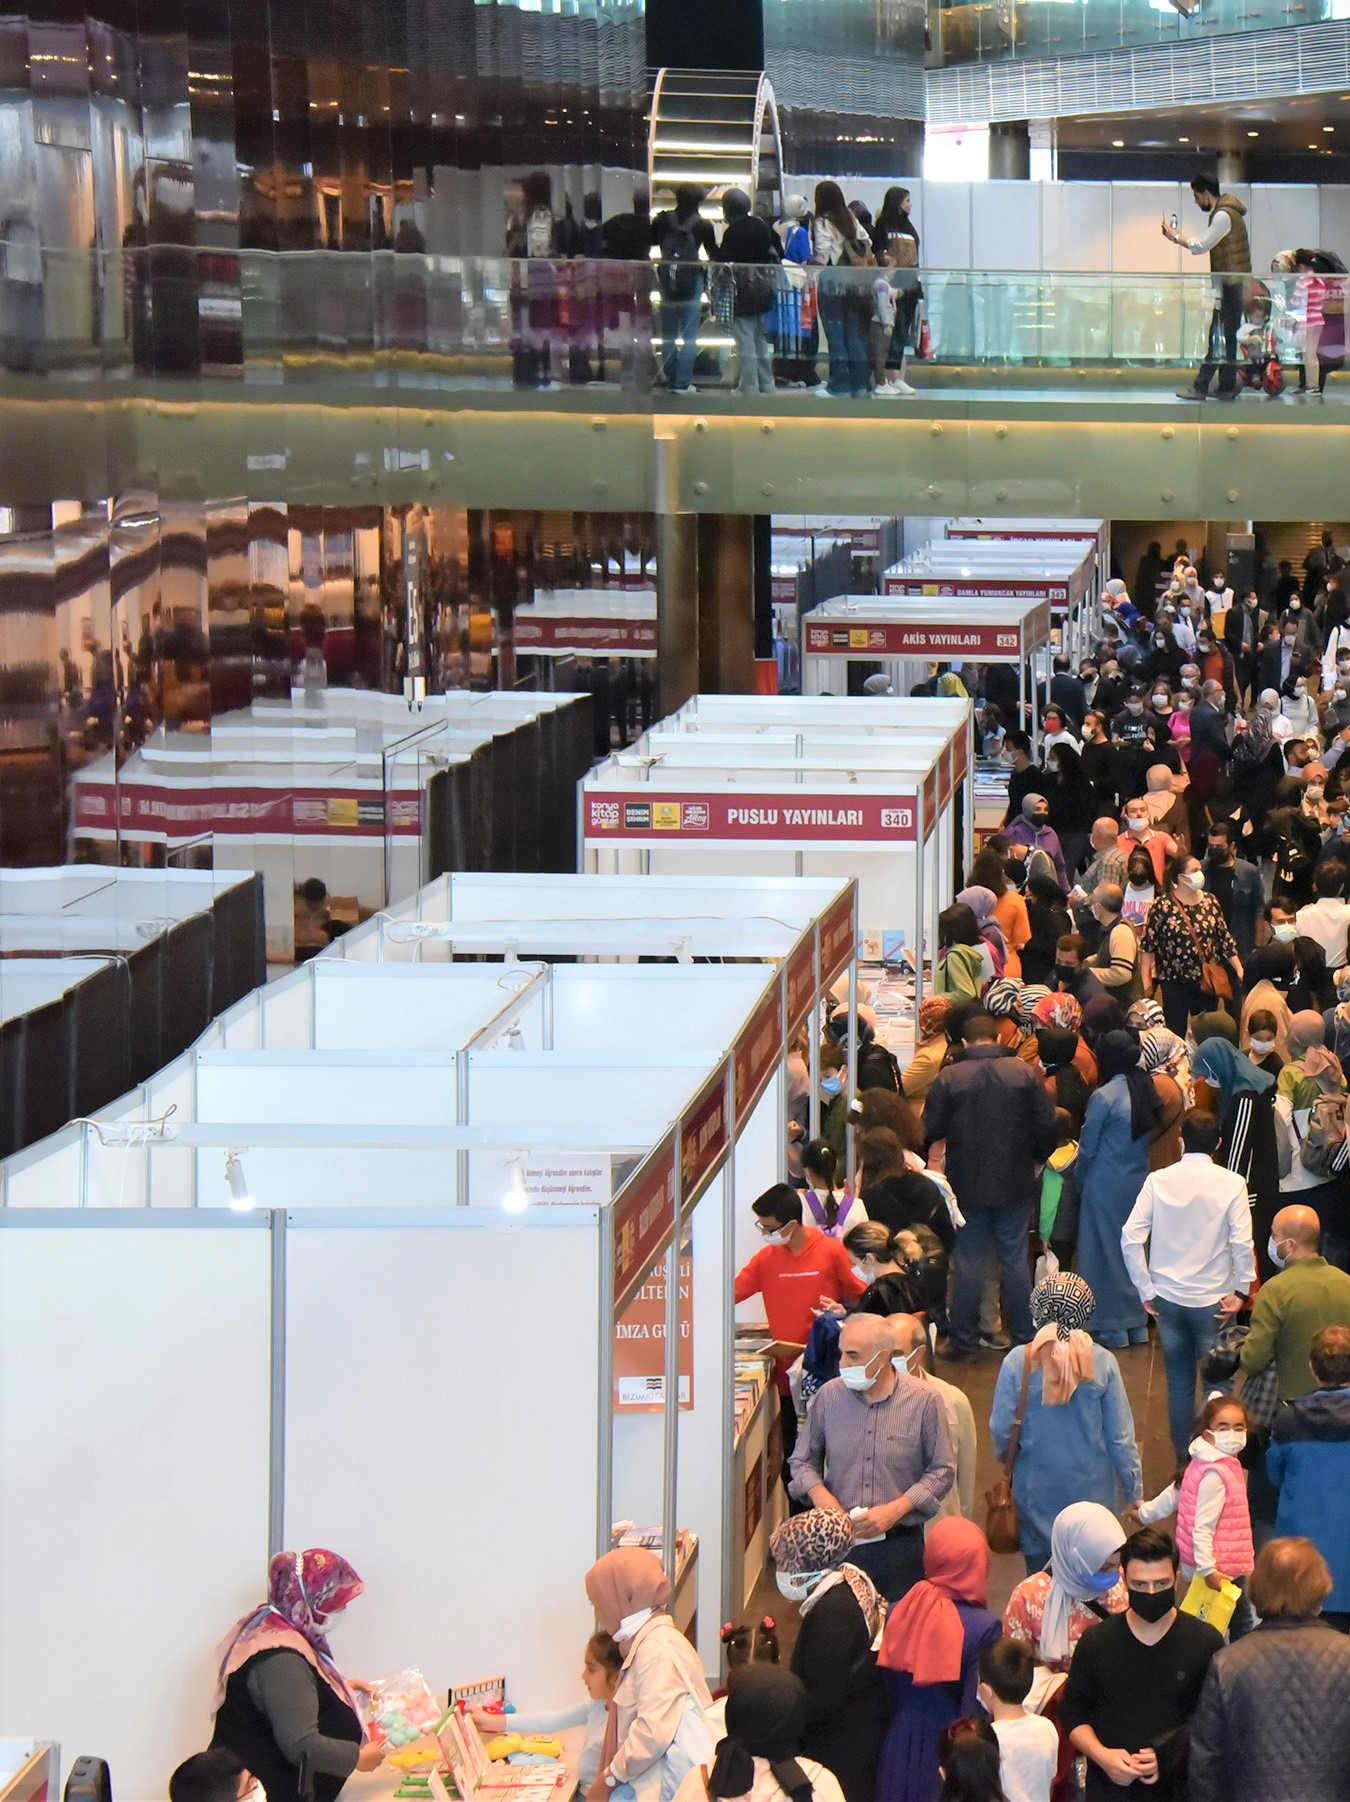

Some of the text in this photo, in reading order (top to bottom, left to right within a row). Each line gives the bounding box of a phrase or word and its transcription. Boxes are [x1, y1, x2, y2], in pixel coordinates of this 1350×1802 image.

[1015, 590, 1047, 598] YAYINLARI
[902, 631, 981, 646] AKİS YAYINLARI
[999, 637, 1015, 646] 342
[591, 801, 619, 811] konya
[591, 808, 619, 819] kitap
[626, 808, 649, 816] BENİM
[727, 808, 863, 826] PUSLU YAYINLARI
[884, 814, 909, 826] 340
[615, 1320, 690, 1339] İMZA GÜ
[622, 1391, 687, 1401] BİZİMKİTAAR
